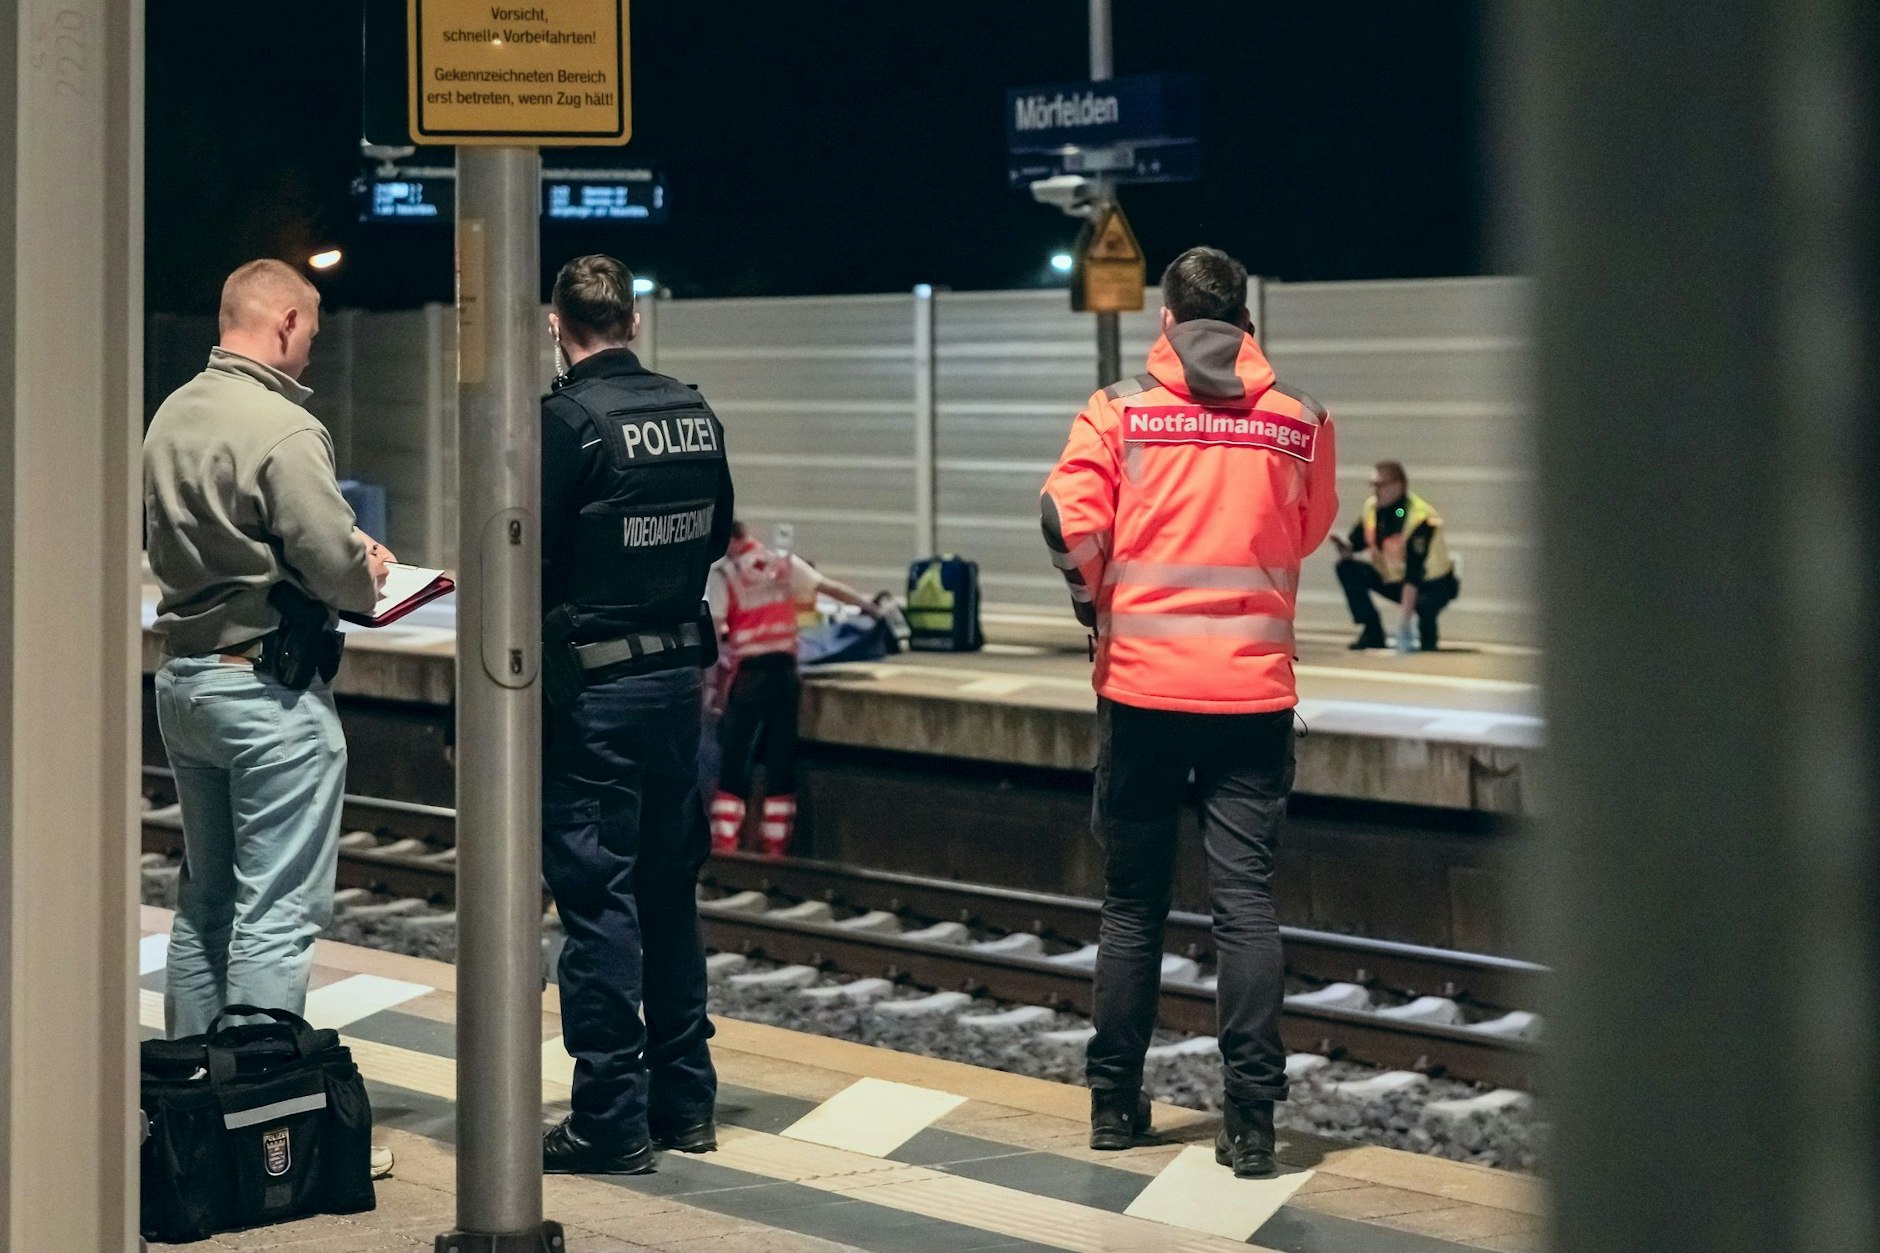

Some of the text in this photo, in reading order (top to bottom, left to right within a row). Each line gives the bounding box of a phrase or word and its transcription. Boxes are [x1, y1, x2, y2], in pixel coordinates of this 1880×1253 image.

[490, 6, 549, 23] Vorsicht,
[442, 27, 597, 45] schnelle Vorbeifahrten!
[434, 66, 606, 84] Gekennzeichneten Bereich
[426, 89, 614, 109] erst betreten, wenn Zug hält!
[1014, 91, 1119, 131] Mörfelden
[621, 418, 718, 459] POLIZEI
[1130, 412, 1310, 448] Notfallmanager
